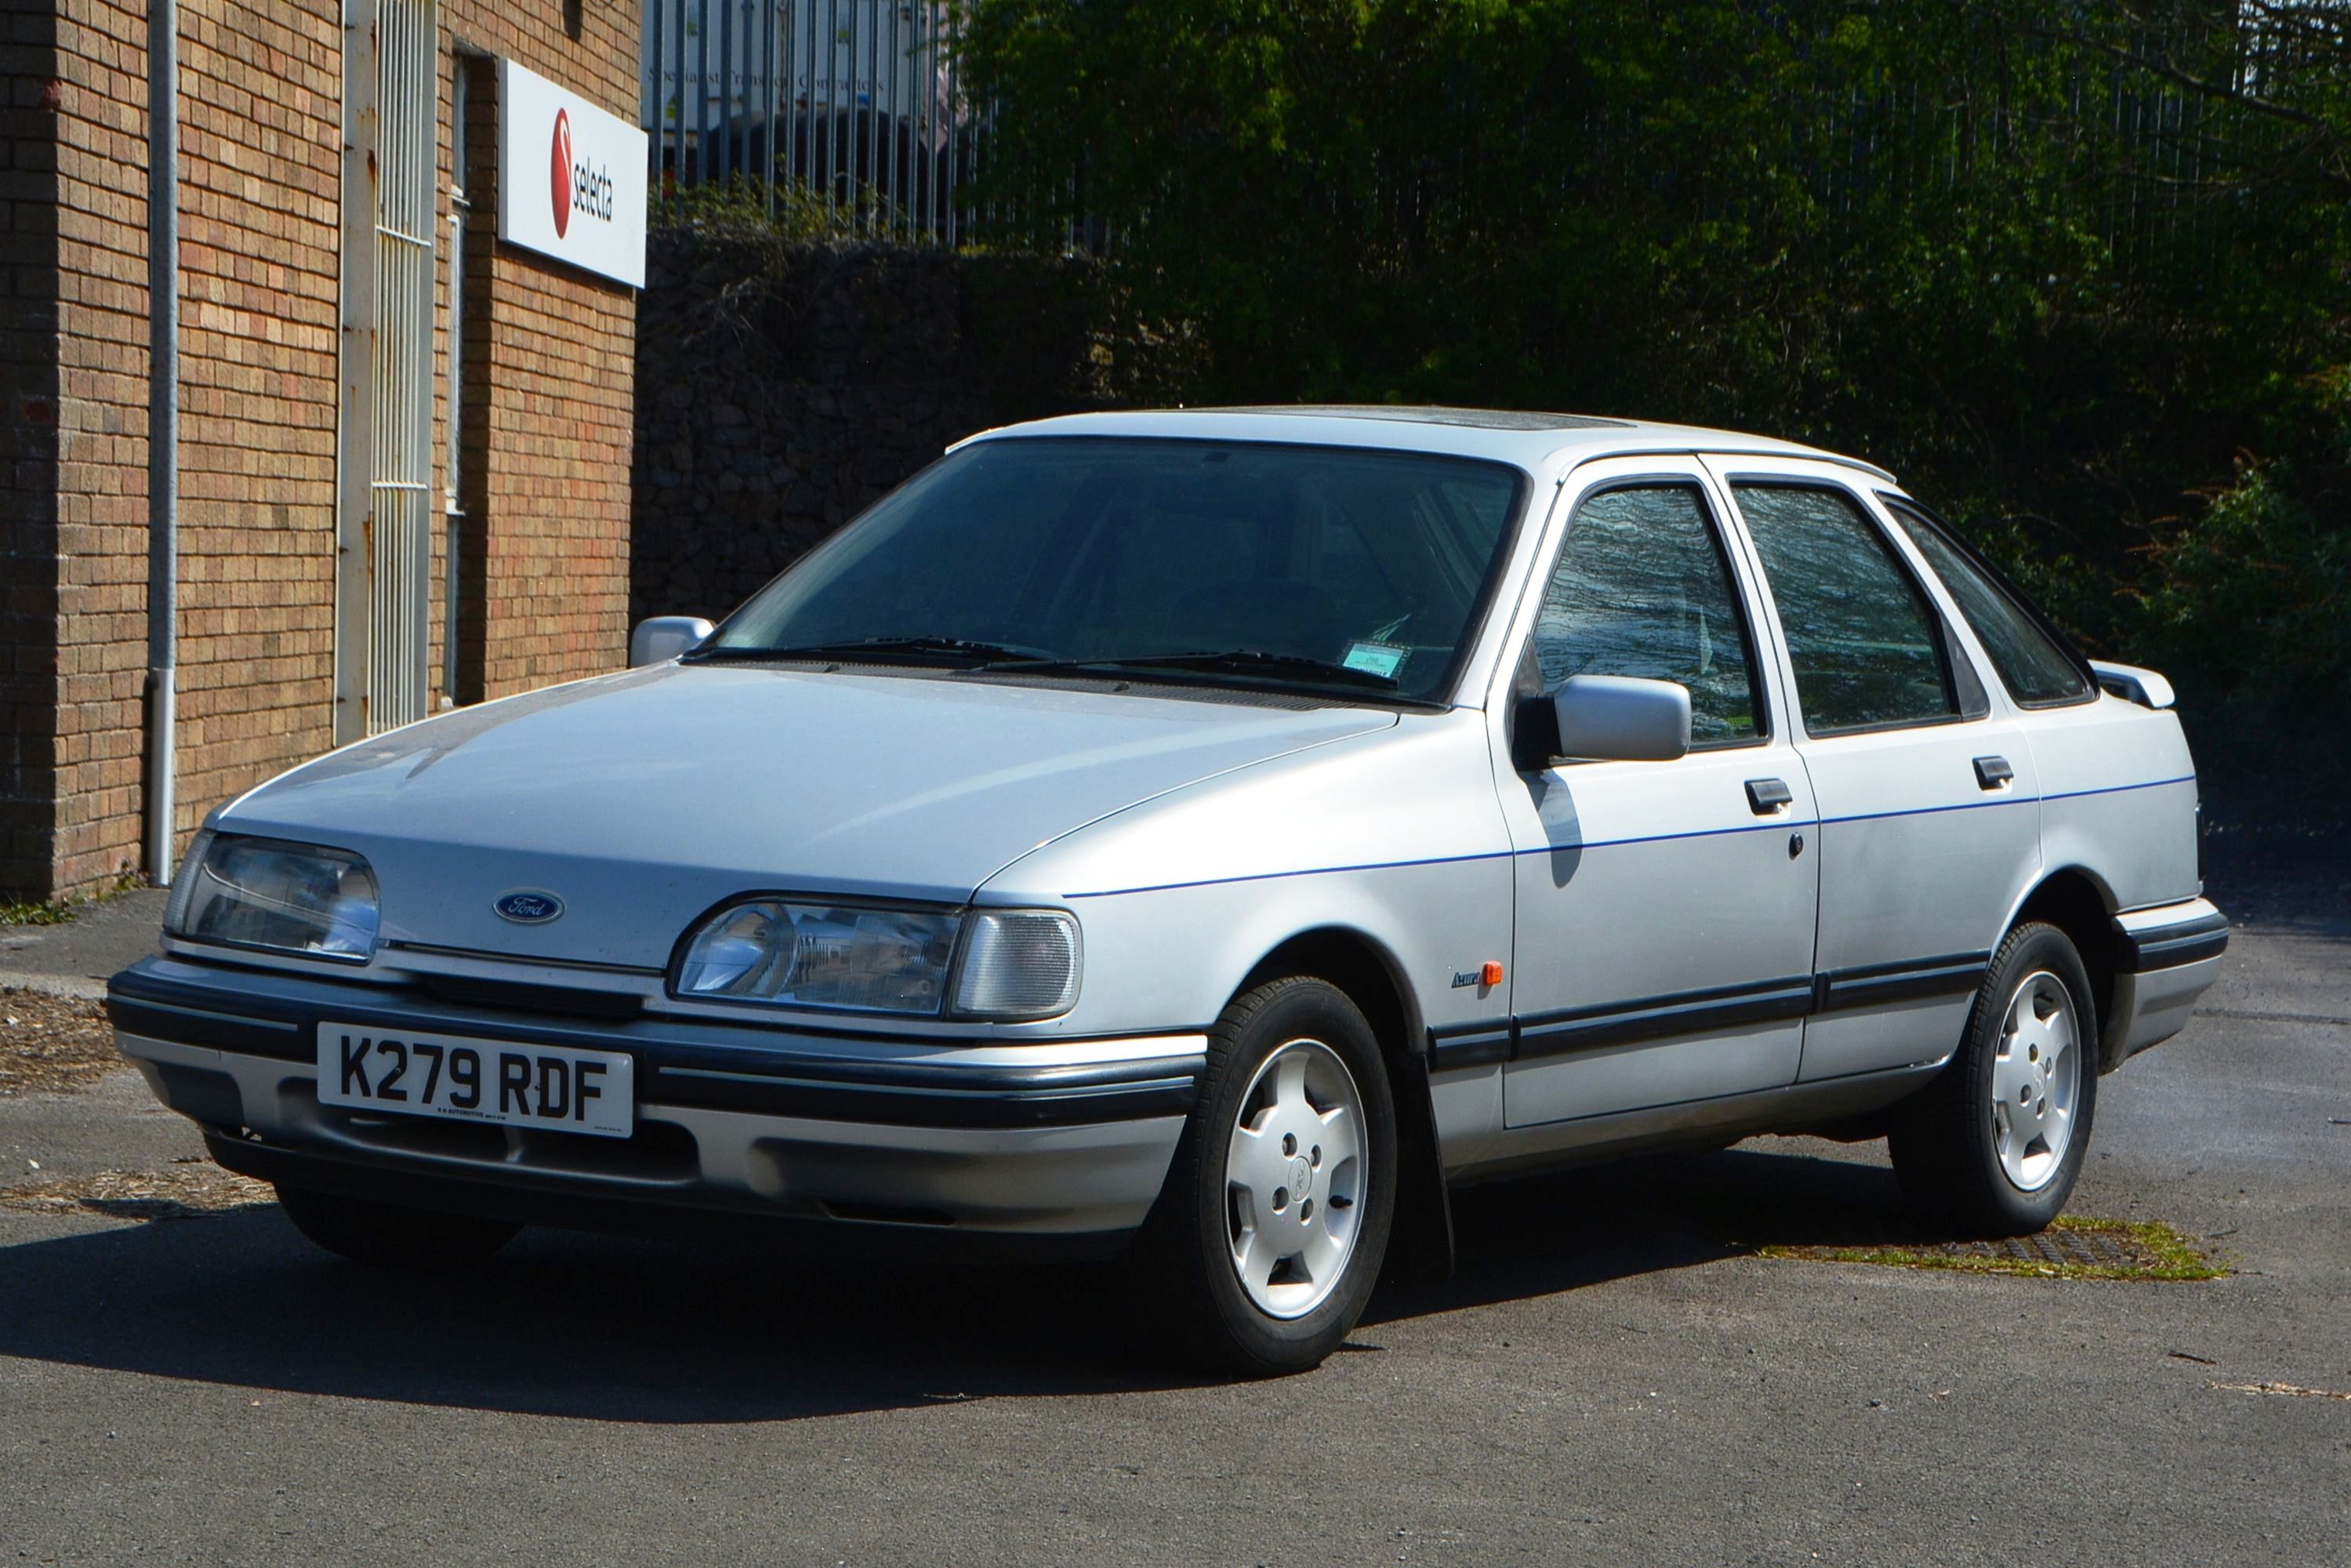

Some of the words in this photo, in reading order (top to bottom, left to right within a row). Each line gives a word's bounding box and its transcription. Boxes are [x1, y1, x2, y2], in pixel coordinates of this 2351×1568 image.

[573, 156, 613, 223] selecta
[508, 896, 546, 916] Ford
[341, 1035, 481, 1109] K279
[499, 1052, 608, 1121] RDF
[448, 1108, 484, 1118] AUTOMOTIVE
